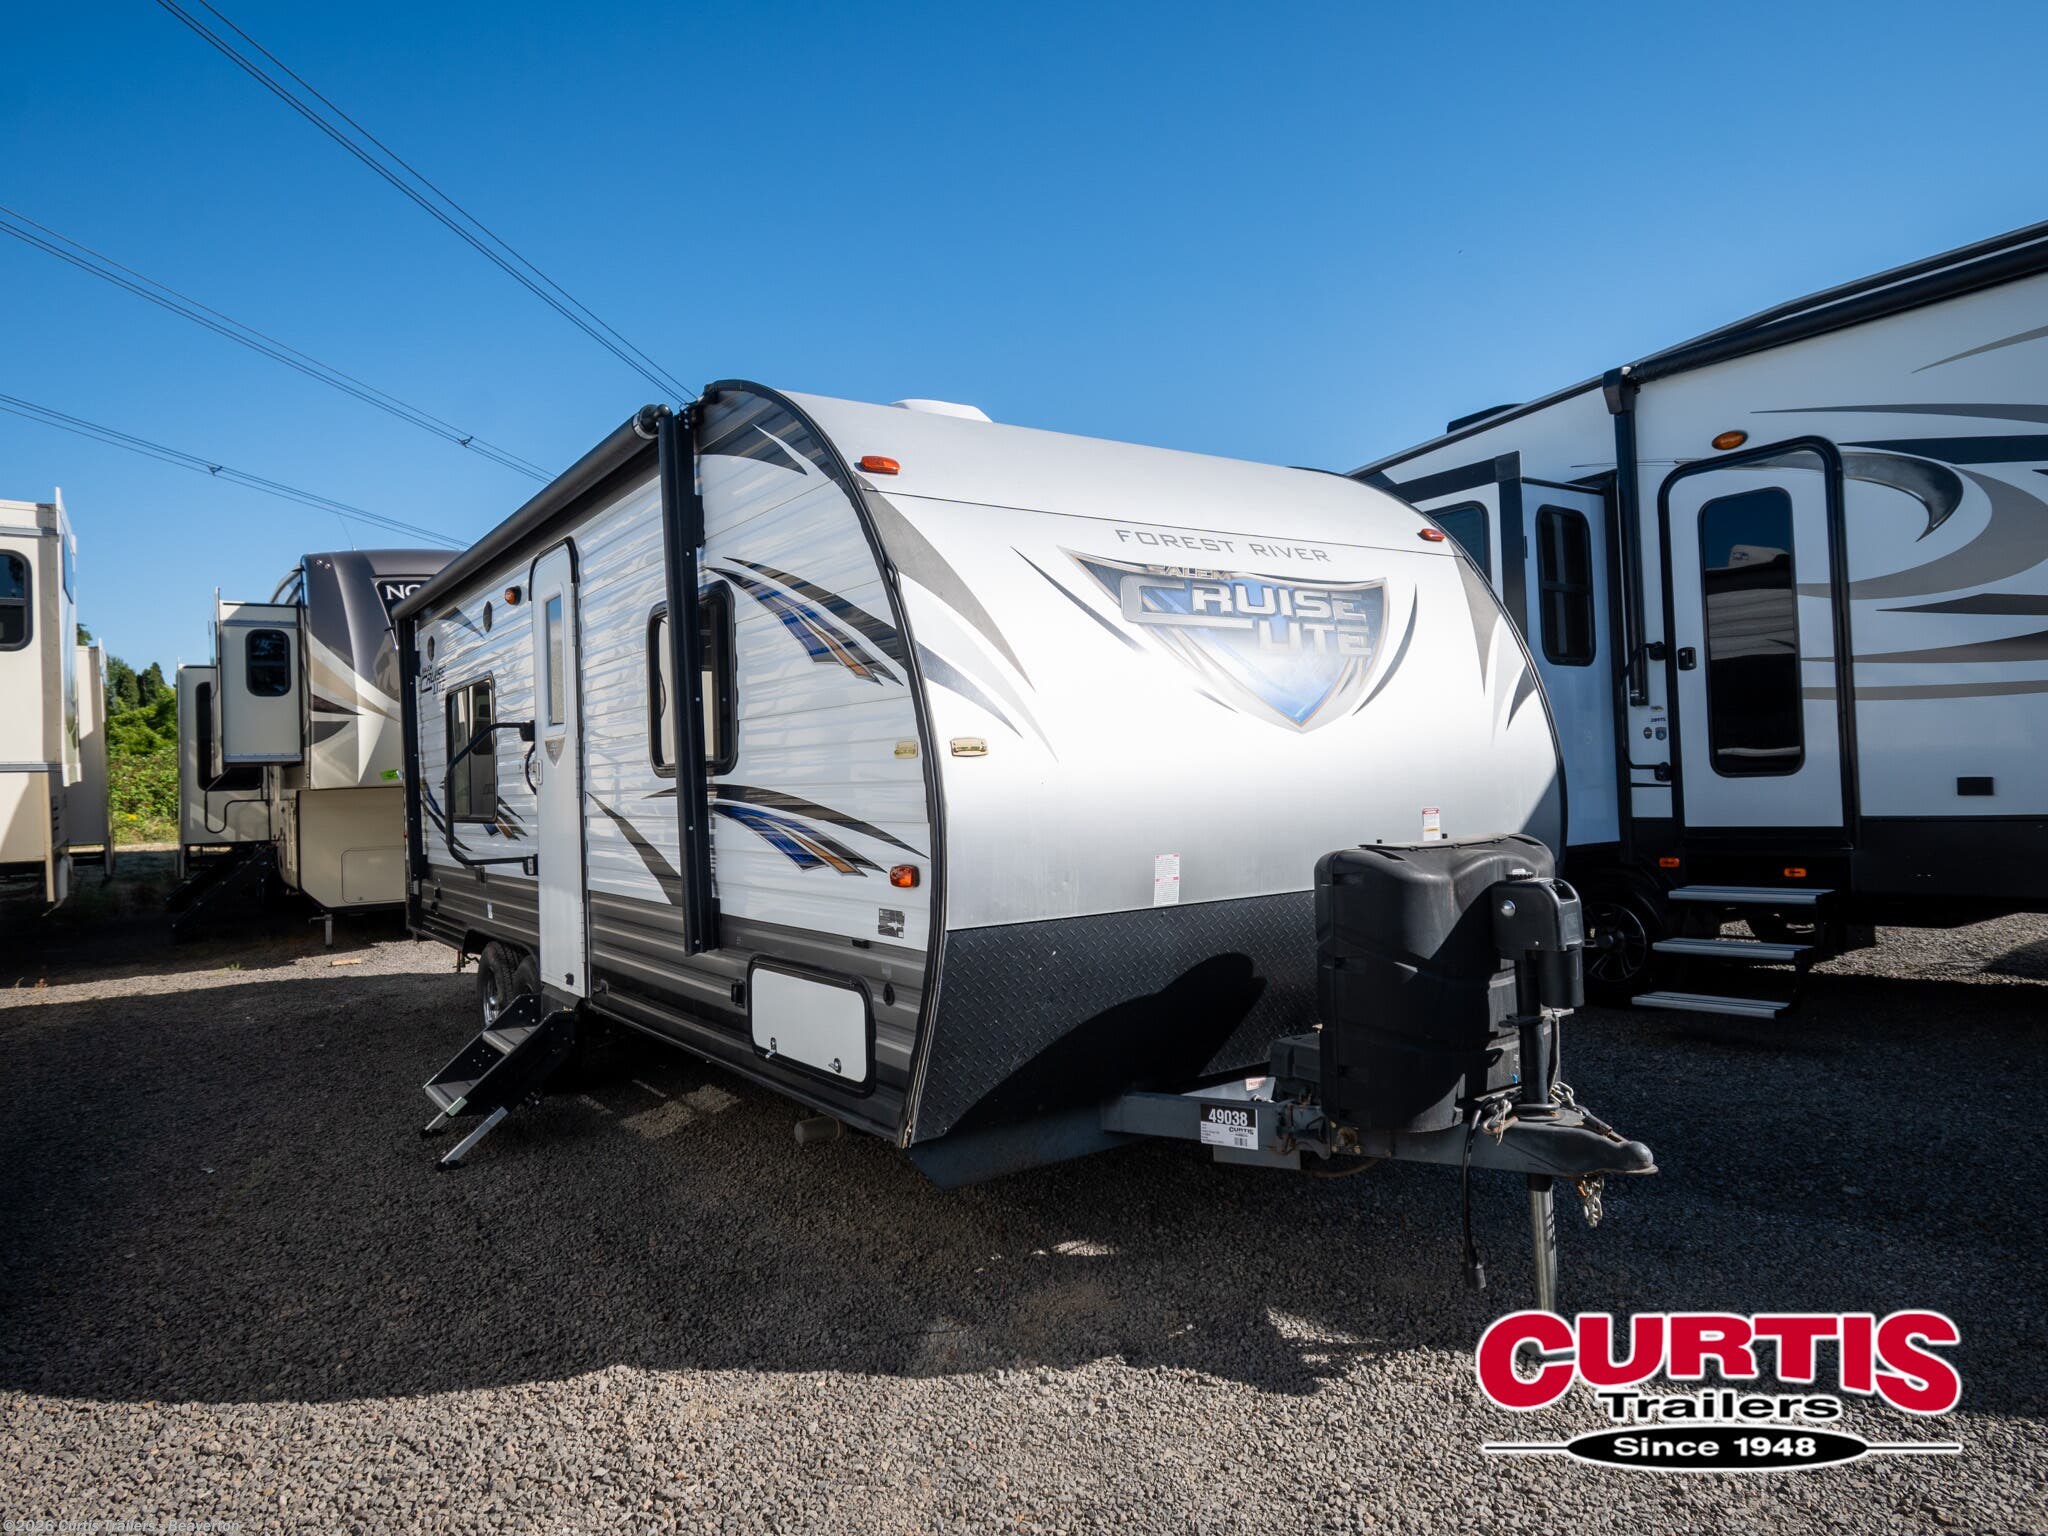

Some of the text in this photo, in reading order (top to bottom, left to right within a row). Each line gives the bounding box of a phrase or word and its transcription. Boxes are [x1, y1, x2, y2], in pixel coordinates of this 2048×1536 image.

[1115, 529, 1331, 562] FOREST RIVER
[1147, 564, 1232, 580] SALEM
[1120, 574, 1367, 630] CRUISE
[1258, 619, 1372, 655] LITE
[1209, 1108, 1248, 1127] 49038
